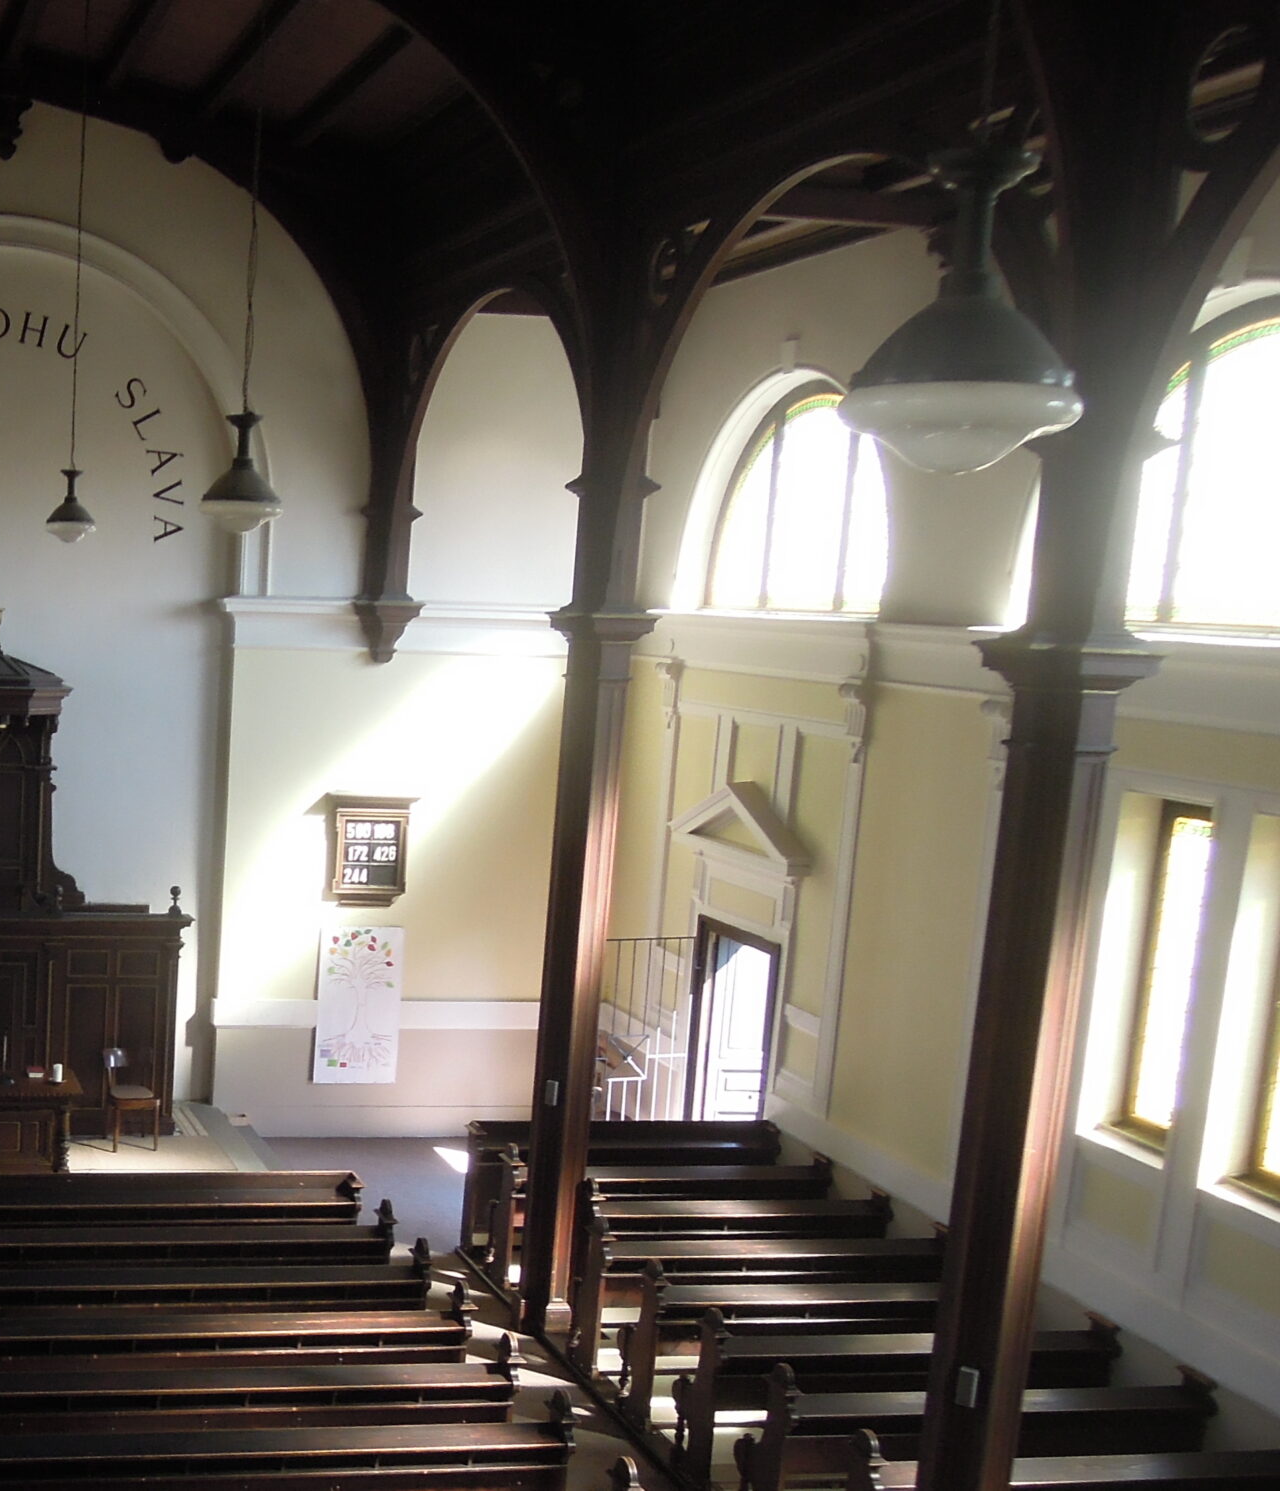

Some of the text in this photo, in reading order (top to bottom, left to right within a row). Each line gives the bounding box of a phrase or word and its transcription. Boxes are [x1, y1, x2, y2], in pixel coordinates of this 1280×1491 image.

[114, 376, 185, 543] SLÁVA
[348, 846, 397, 861] 172 426
[343, 868, 368, 883] 244
